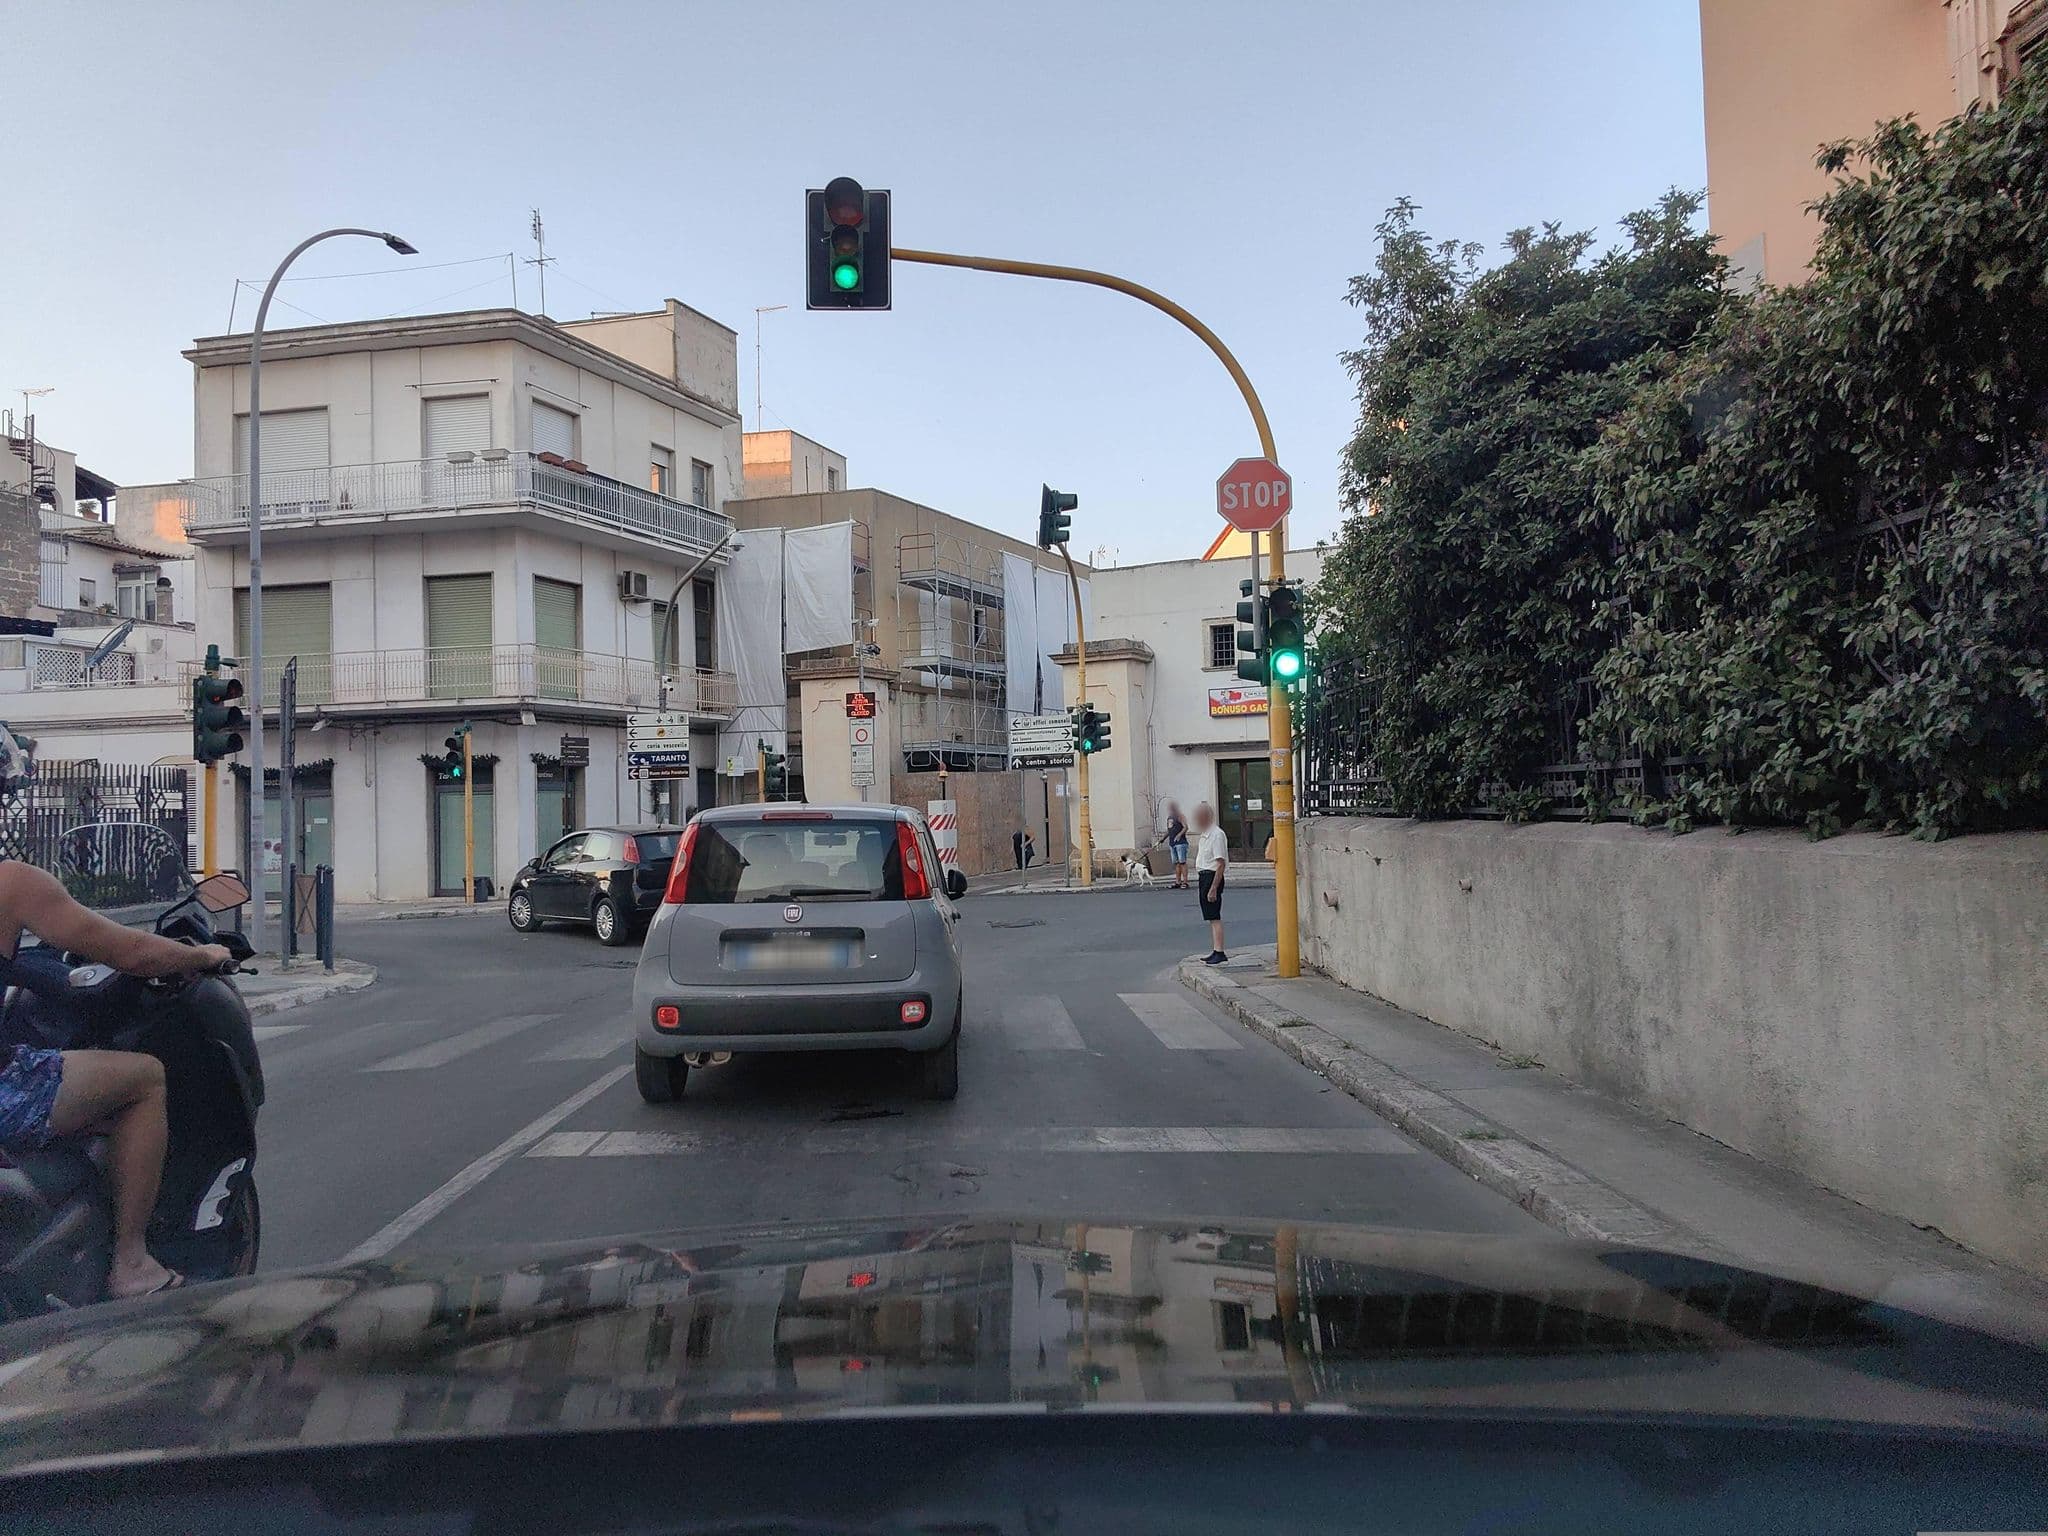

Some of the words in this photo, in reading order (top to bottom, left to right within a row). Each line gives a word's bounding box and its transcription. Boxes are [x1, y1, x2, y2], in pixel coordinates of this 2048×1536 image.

[1223, 481, 1287, 509] STOP
[1211, 705, 1248, 714] BONUSO
[1250, 704, 1268, 712] GAS
[788, 909, 798, 918] FIAT
